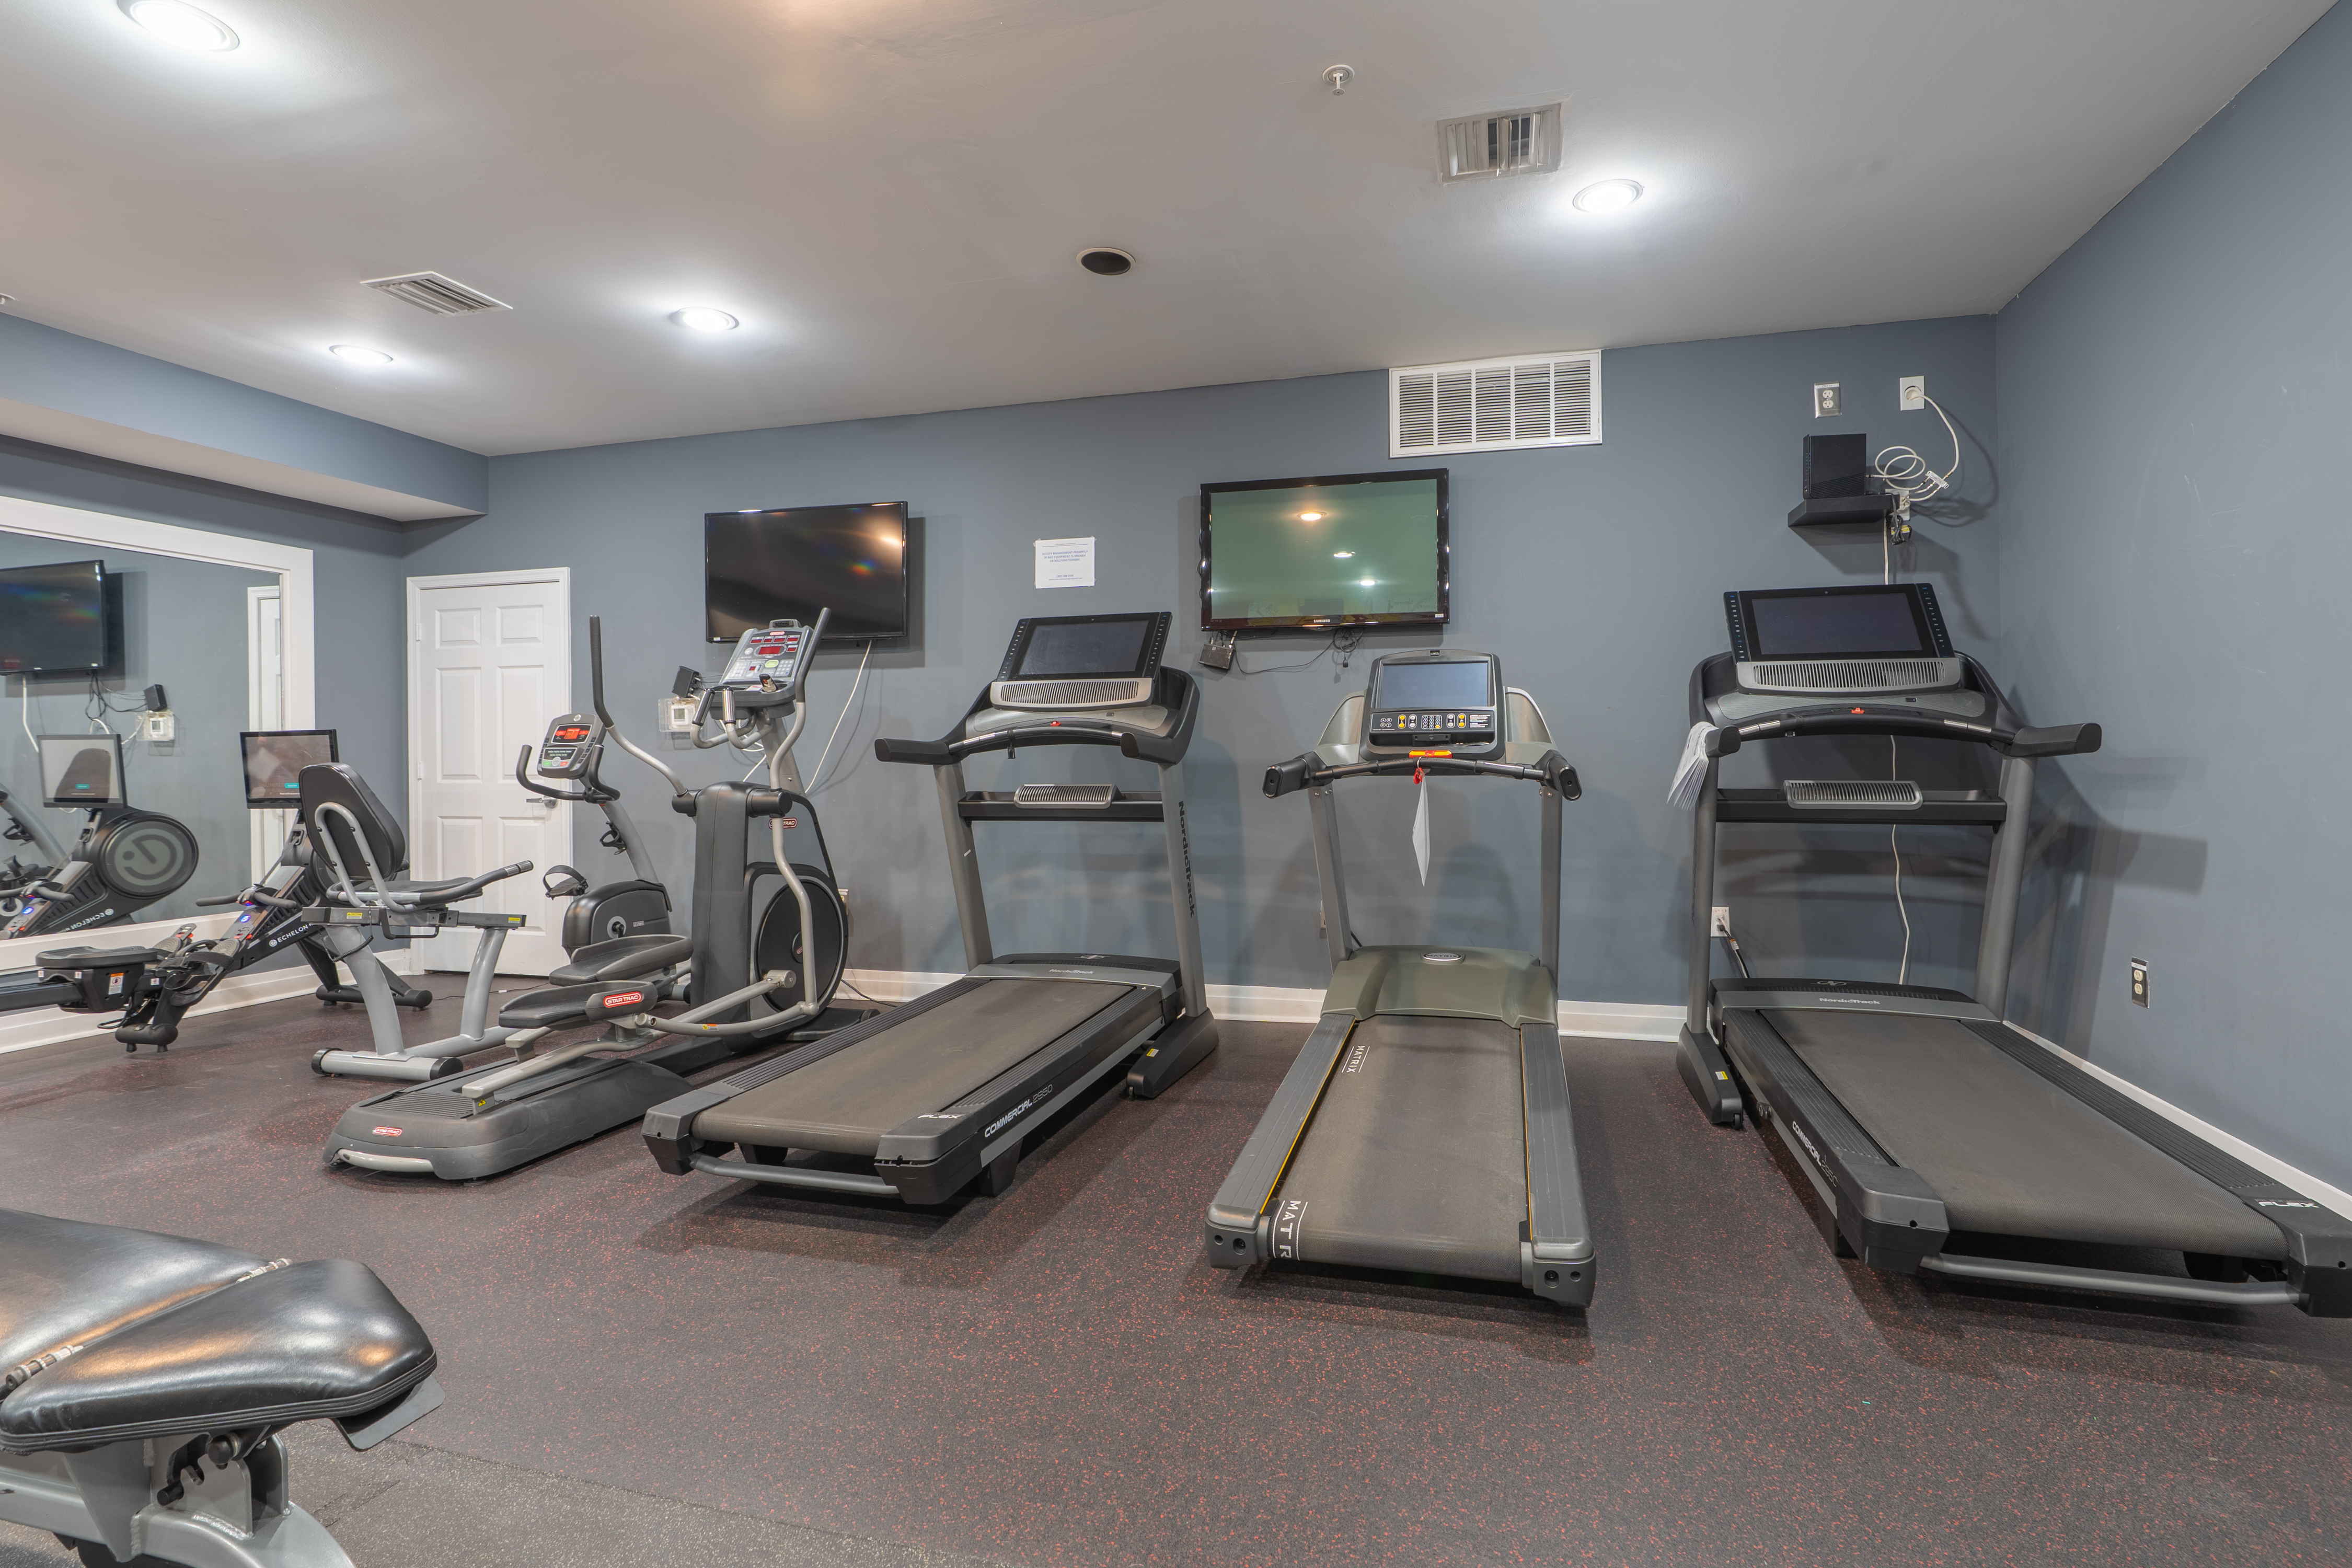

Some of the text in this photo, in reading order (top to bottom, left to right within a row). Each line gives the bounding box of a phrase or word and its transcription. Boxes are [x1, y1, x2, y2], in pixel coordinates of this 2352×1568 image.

[1178, 800, 1195, 918] NordicTrack
[277, 924, 309, 943] ECHELON
[1346, 1045, 1365, 1073] MATRIX
[985, 1084, 1053, 1138] COMMERCIAL 2950
[1792, 1121, 1821, 1166] COMMERCIAL
